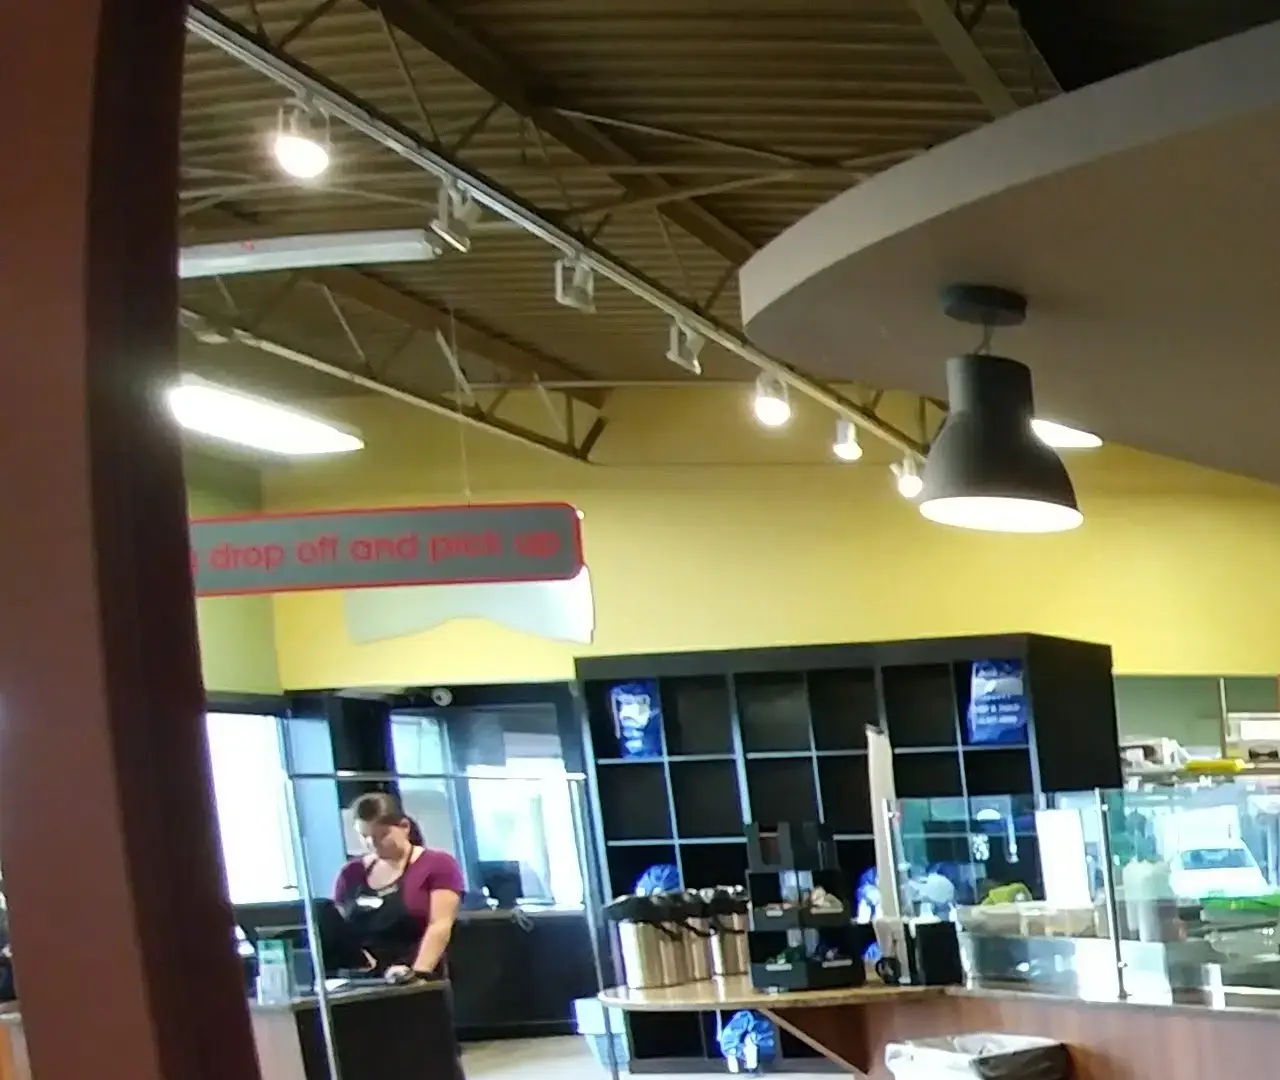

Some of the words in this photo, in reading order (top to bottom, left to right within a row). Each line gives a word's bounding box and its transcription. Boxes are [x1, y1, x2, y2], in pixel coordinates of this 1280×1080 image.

[208, 541, 285, 571] drop
[295, 533, 339, 564] off
[351, 532, 418, 562] and
[430, 530, 501, 564] pick
[511, 530, 560, 561] up
